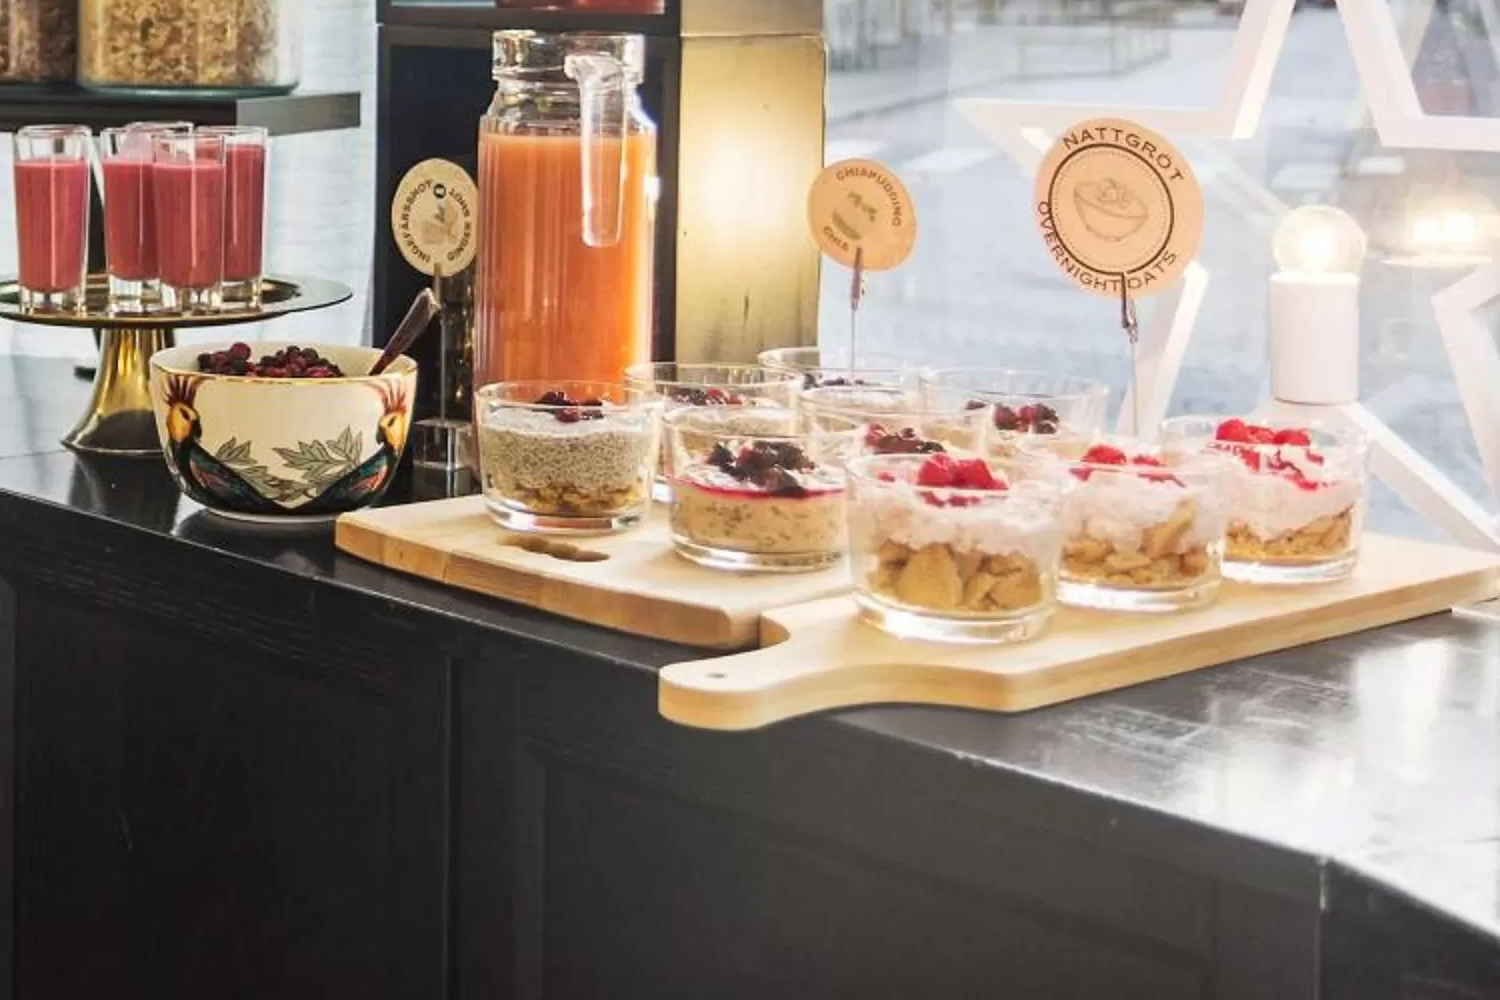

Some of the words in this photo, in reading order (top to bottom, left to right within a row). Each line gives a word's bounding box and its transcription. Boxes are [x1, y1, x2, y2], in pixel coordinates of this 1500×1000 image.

[1063, 127, 1184, 181] NATTGRÖT
[1037, 201, 1123, 292] OVERNIGHT
[1127, 250, 1177, 290] OATS
